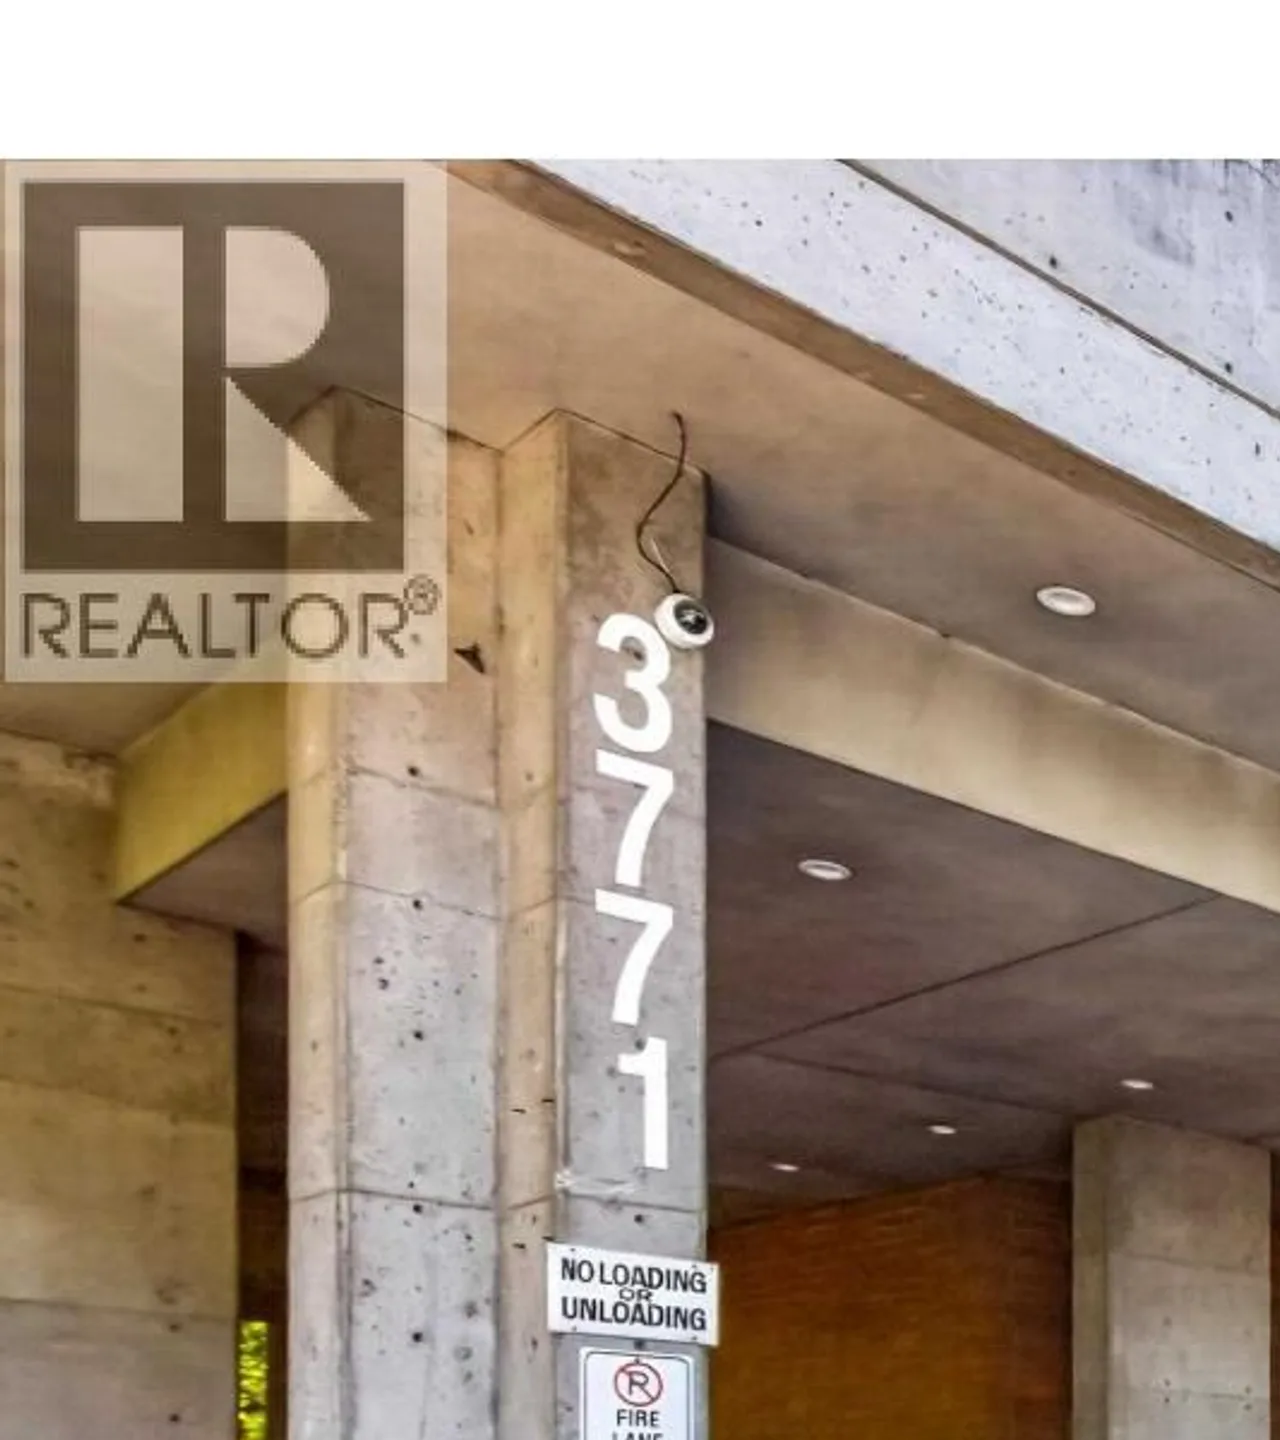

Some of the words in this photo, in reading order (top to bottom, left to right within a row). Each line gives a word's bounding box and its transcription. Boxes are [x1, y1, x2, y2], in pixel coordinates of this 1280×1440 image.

[594, 612, 674, 1171] 3771
[561, 1257, 594, 1282] NO
[600, 1261, 707, 1294] LOADING
[619, 1287, 653, 1302] OR
[561, 1297, 707, 1331] UNLOADING
[616, 1408, 660, 1428] FIRE
